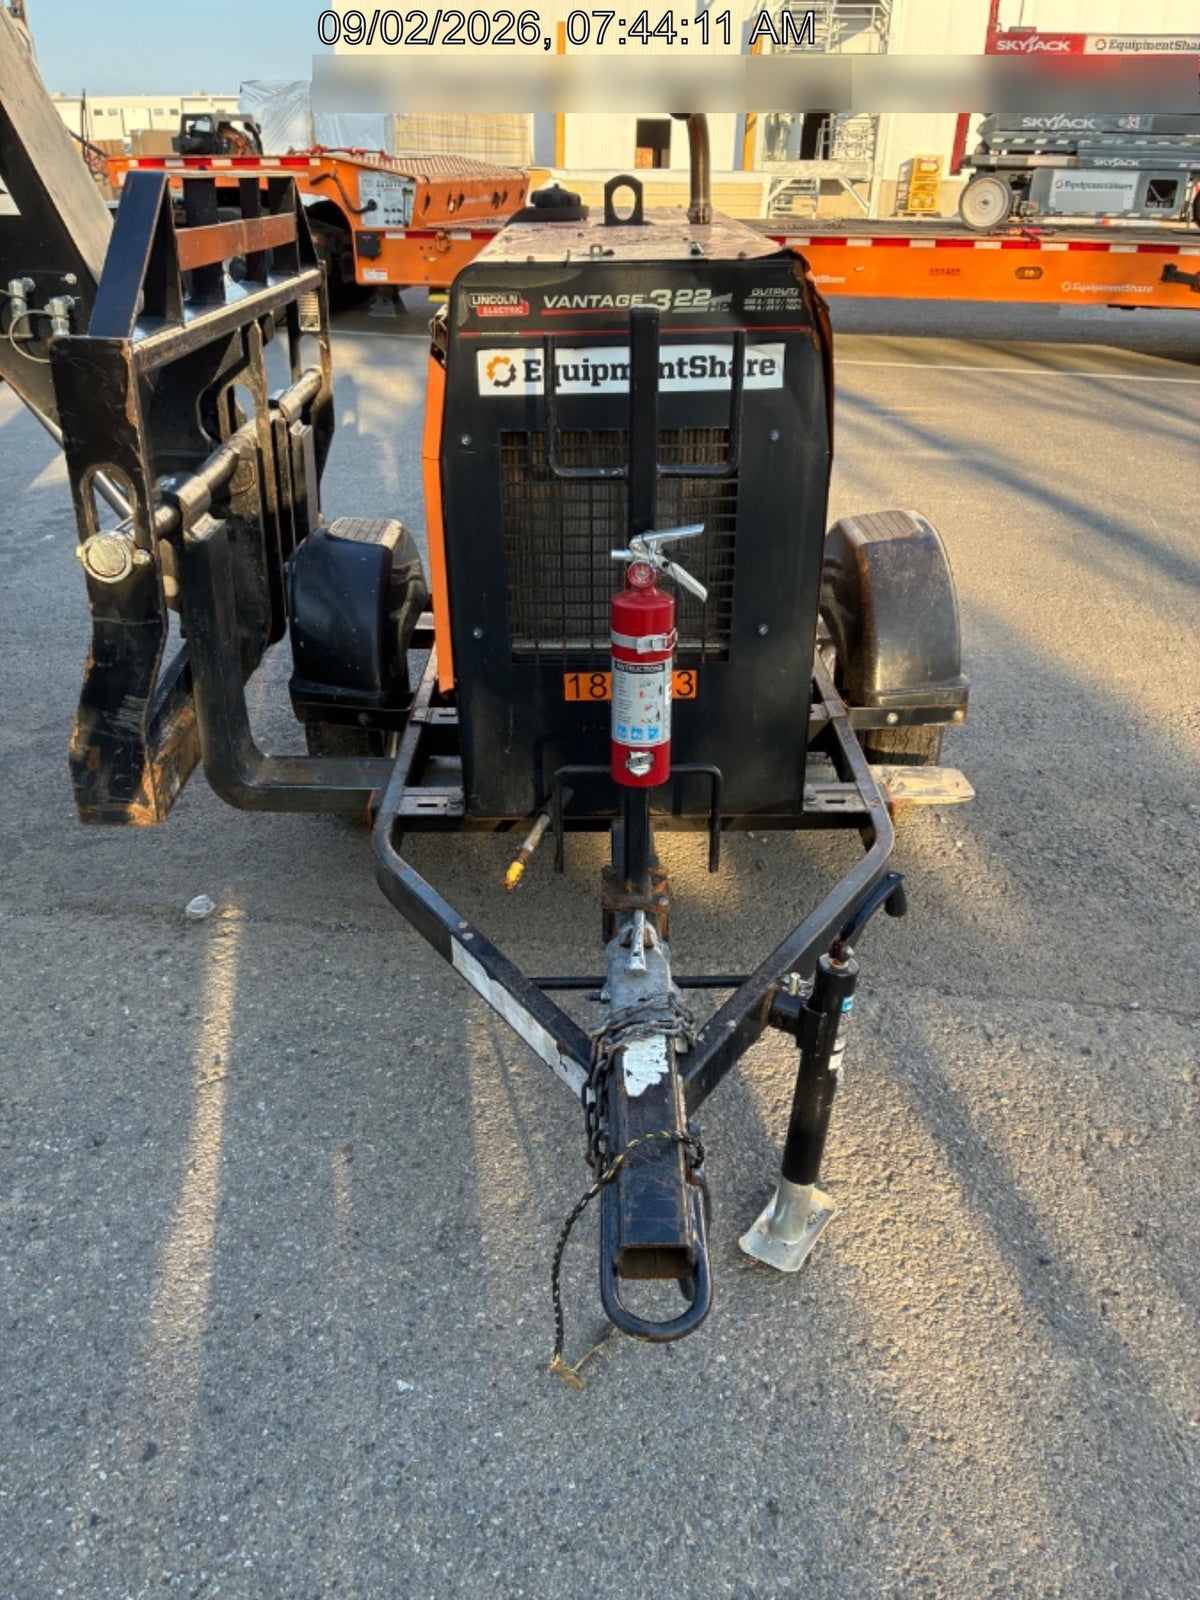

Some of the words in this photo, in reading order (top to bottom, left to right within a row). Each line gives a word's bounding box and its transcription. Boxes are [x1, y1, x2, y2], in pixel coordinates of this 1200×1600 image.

[996, 35, 1071, 52] SKYJACK
[1108, 38, 1200, 51] EquipmentSha
[1022, 114, 1096, 130] SKYJACK
[472, 294, 518, 305] LINCOLN
[543, 294, 644, 308] VANTAGE
[650, 288, 712, 312] 322
[483, 304, 524, 314] ELECTRIC
[522, 354, 776, 387] EuipmntShre
